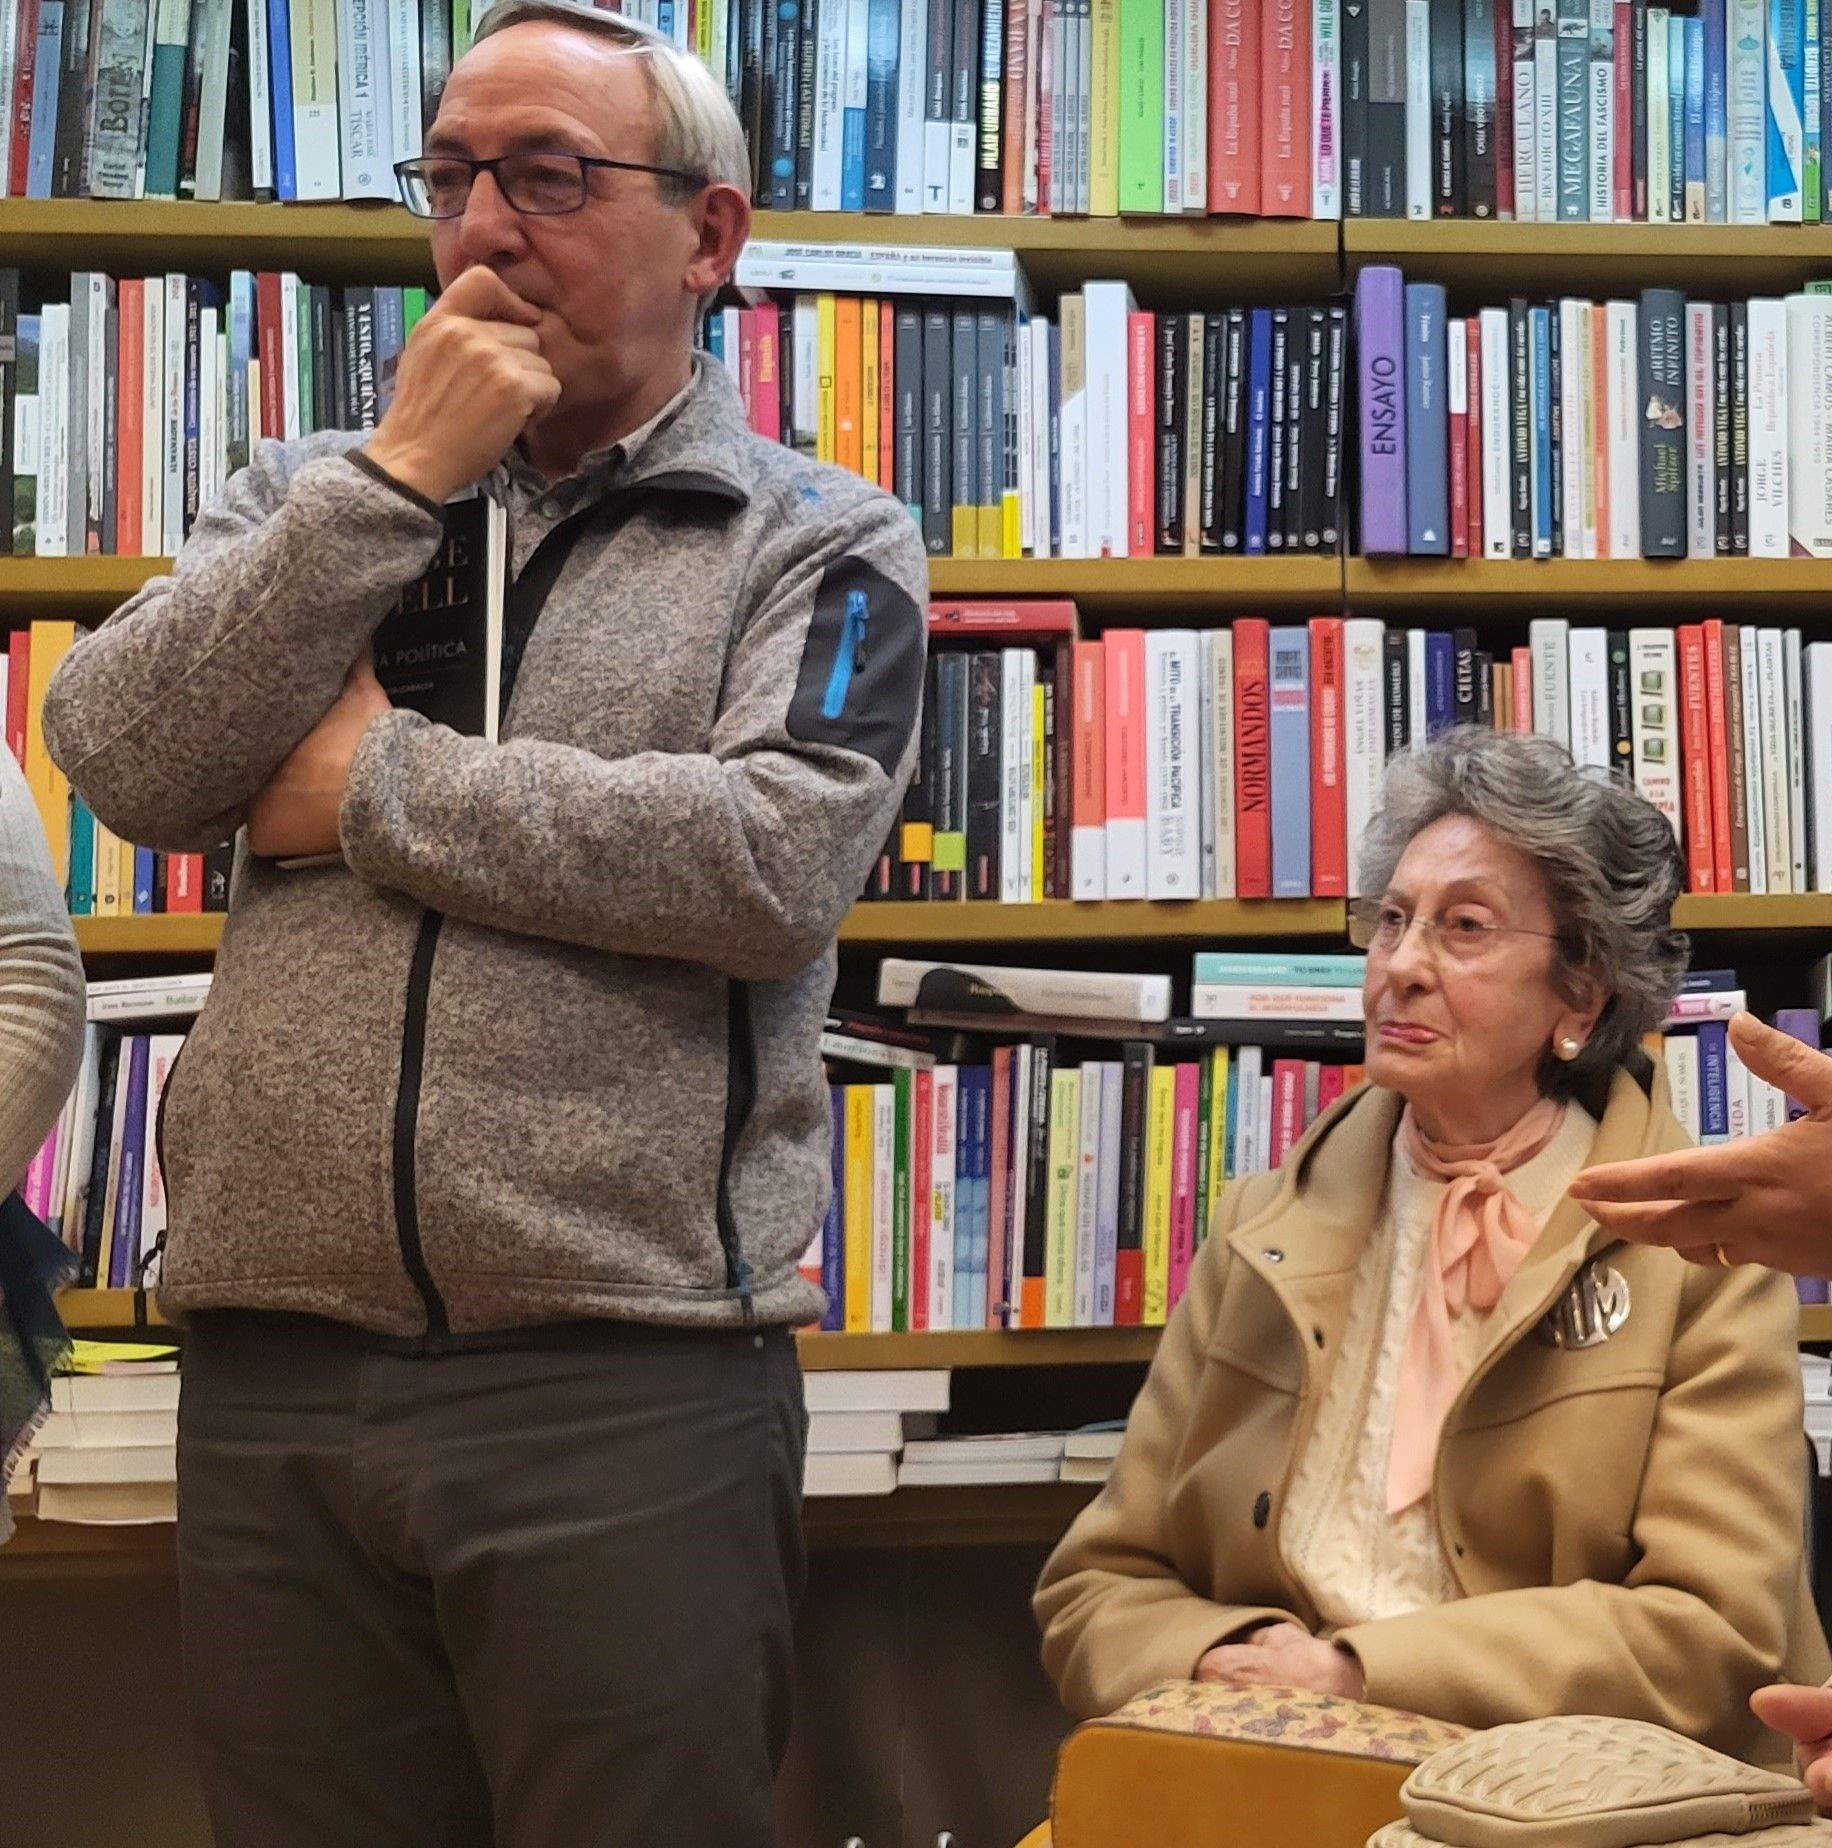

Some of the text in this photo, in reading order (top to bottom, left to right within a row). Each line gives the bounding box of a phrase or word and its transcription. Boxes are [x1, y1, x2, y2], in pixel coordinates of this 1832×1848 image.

[981, 82, 1000, 132] URBANO
[1226, 104, 1240, 139] España
[1278, 107, 1292, 142] España
[1320, 124, 1331, 142] QUE
[1517, 72, 1532, 194] HERCULANO
[1564, 58, 1582, 195] MEGAFAUNA
[1596, 68, 1607, 208] HISTORIA DEL FASCISMO
[1673, 161, 1682, 181] vida
[1650, 320, 1663, 370] RITMO
[1666, 316, 1679, 386] INFINITO
[1371, 356, 1397, 455] ENSAYO
[1654, 444, 1667, 494] Michael
[1756, 458, 1768, 502] JORGE
[1456, 649, 1472, 703] CELTAS
[1240, 679, 1268, 813] NORMANDOS
[1708, 1054, 1720, 1130] INTELIGENCIA
